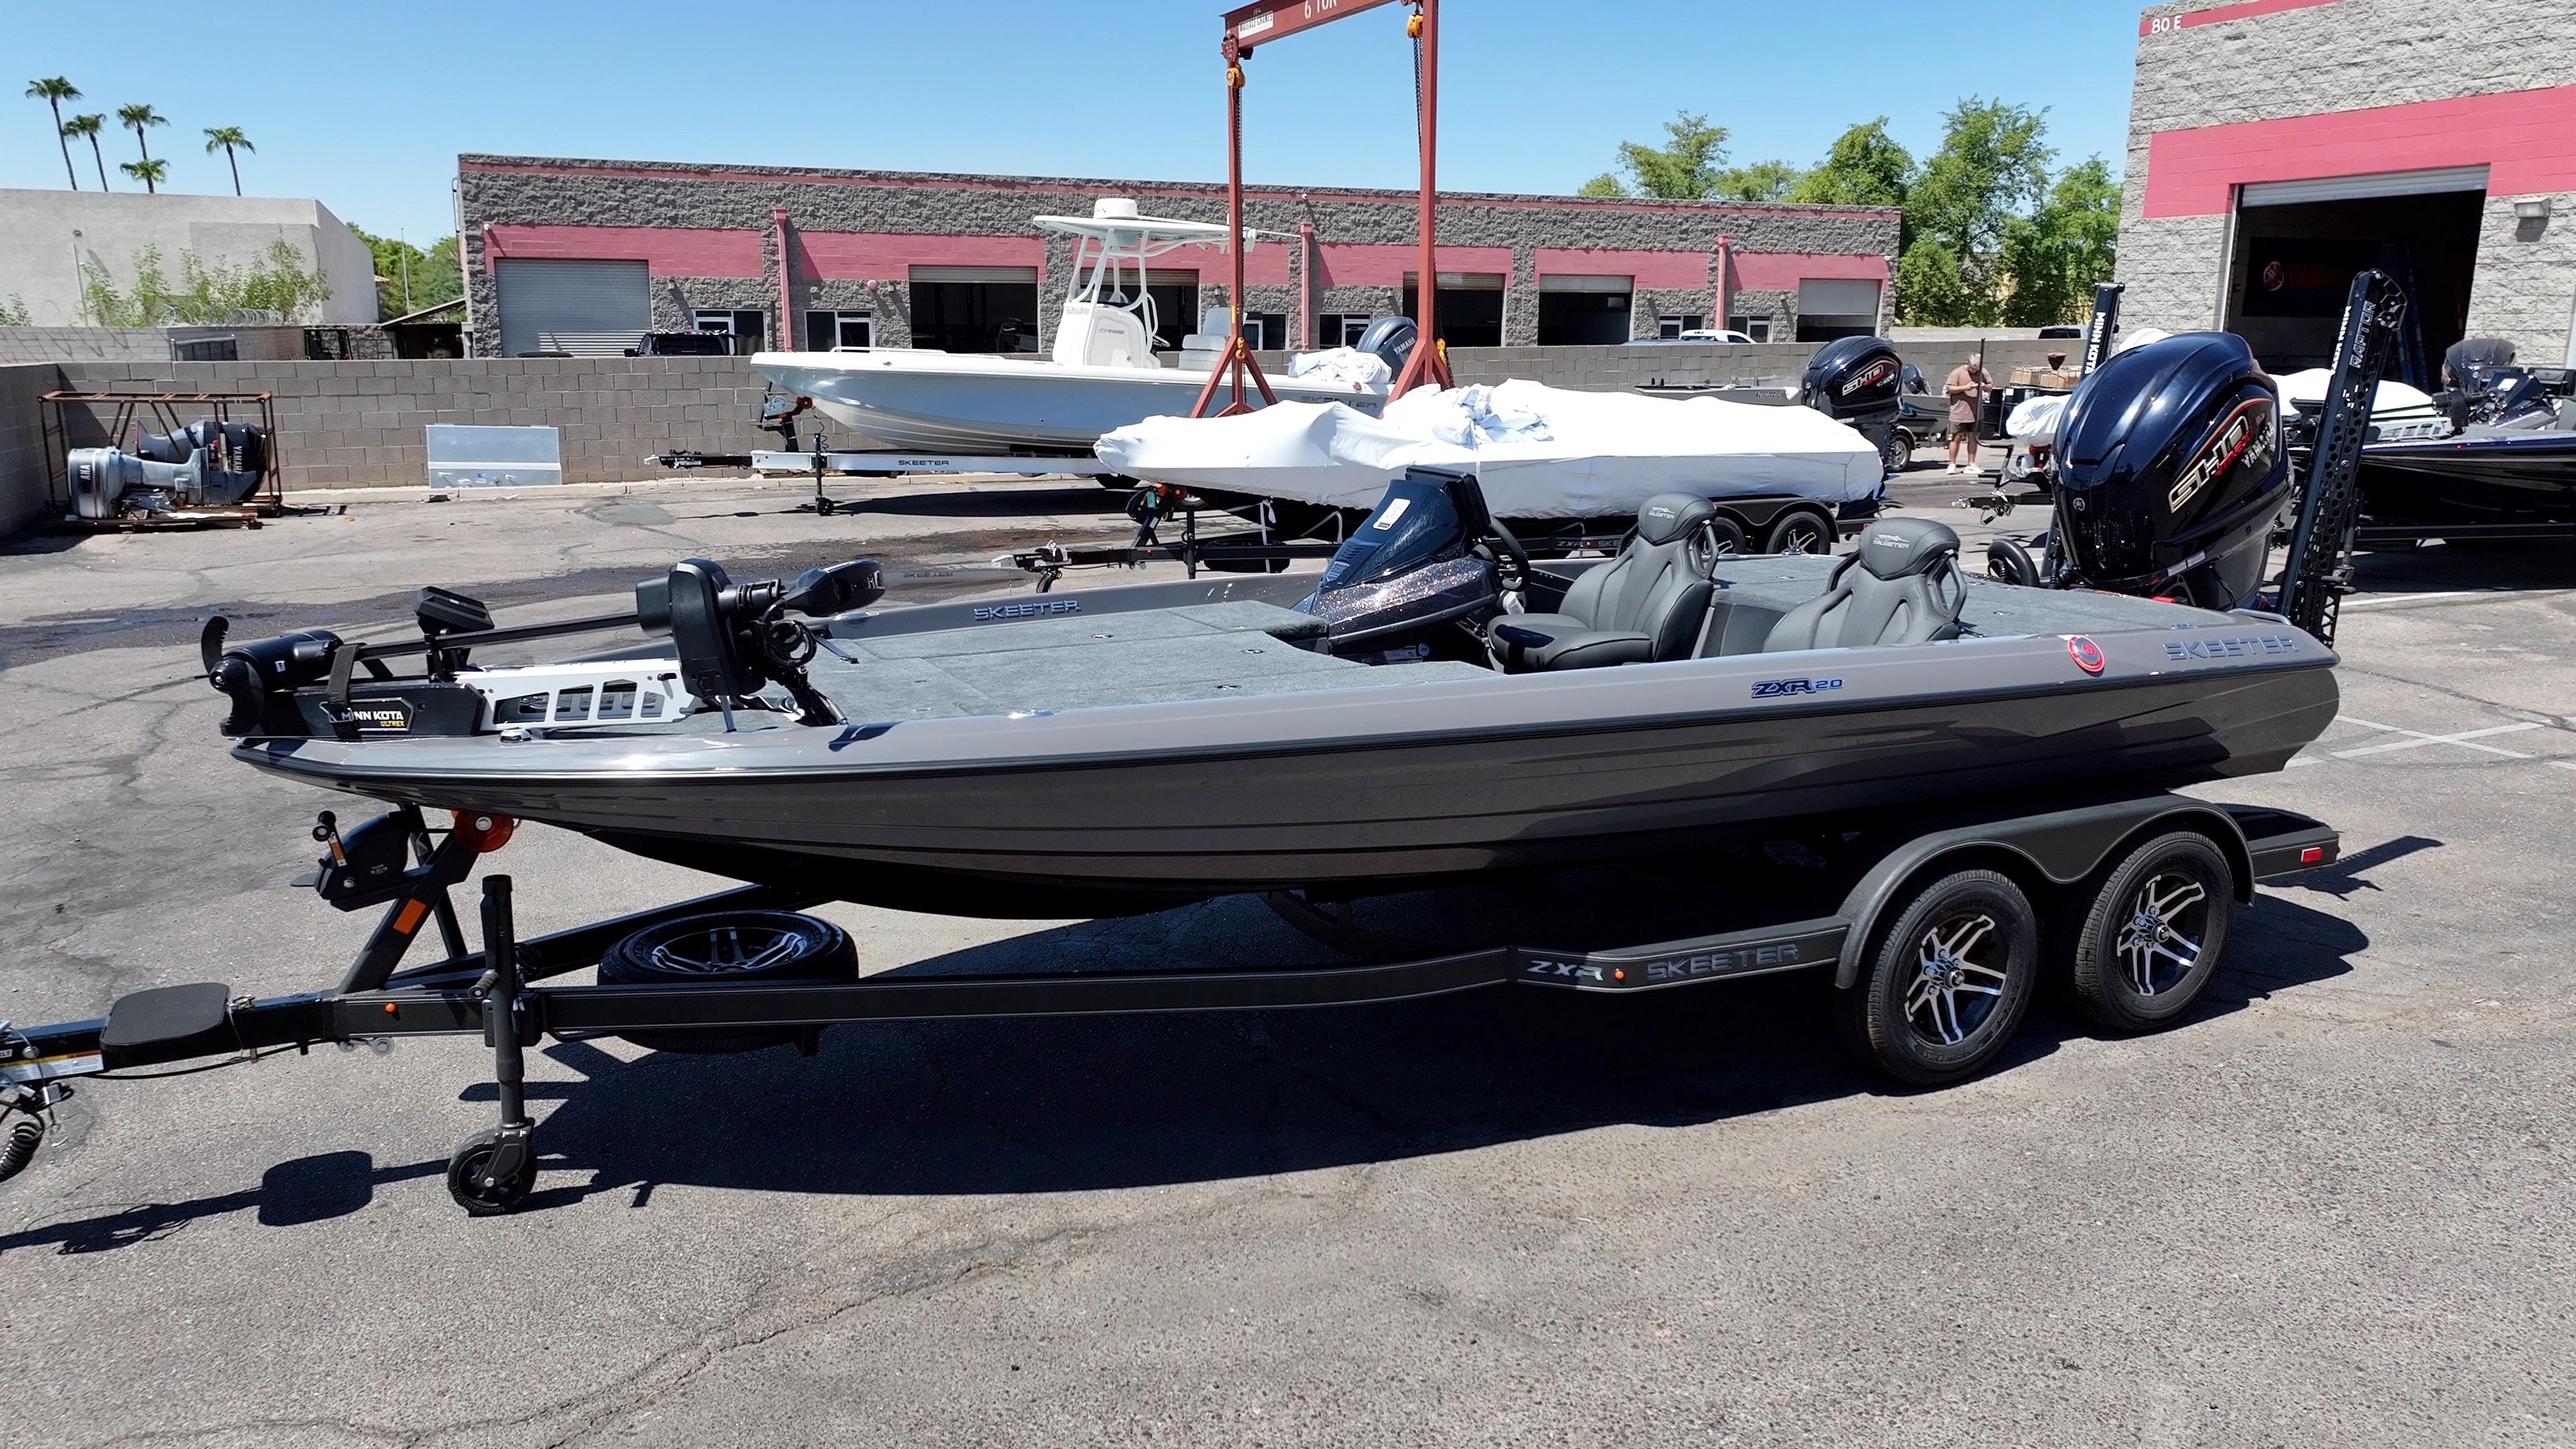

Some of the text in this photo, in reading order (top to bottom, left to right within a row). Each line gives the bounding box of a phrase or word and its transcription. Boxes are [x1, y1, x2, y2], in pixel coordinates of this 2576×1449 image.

[1304, 0, 1311, 19] 6
[2151, 15, 2183, 34] 80 E
[2338, 305, 2352, 341] MINN
[2349, 300, 2377, 369] RAPTOR
[1393, 336, 1416, 355] YAMAHA
[2084, 312, 2106, 374] MINN KOTA
[1841, 365, 1884, 396] SHO
[2241, 421, 2275, 469] YAMAHA
[2167, 415, 2249, 514] SHO
[973, 600, 1081, 621] SKEETER
[2162, 635, 2301, 661] SKEETER
[1750, 677, 1845, 699] ZXR 20
[372, 711, 405, 720] KOTA
[1525, 943, 1799, 981] ZXR SKEETER
